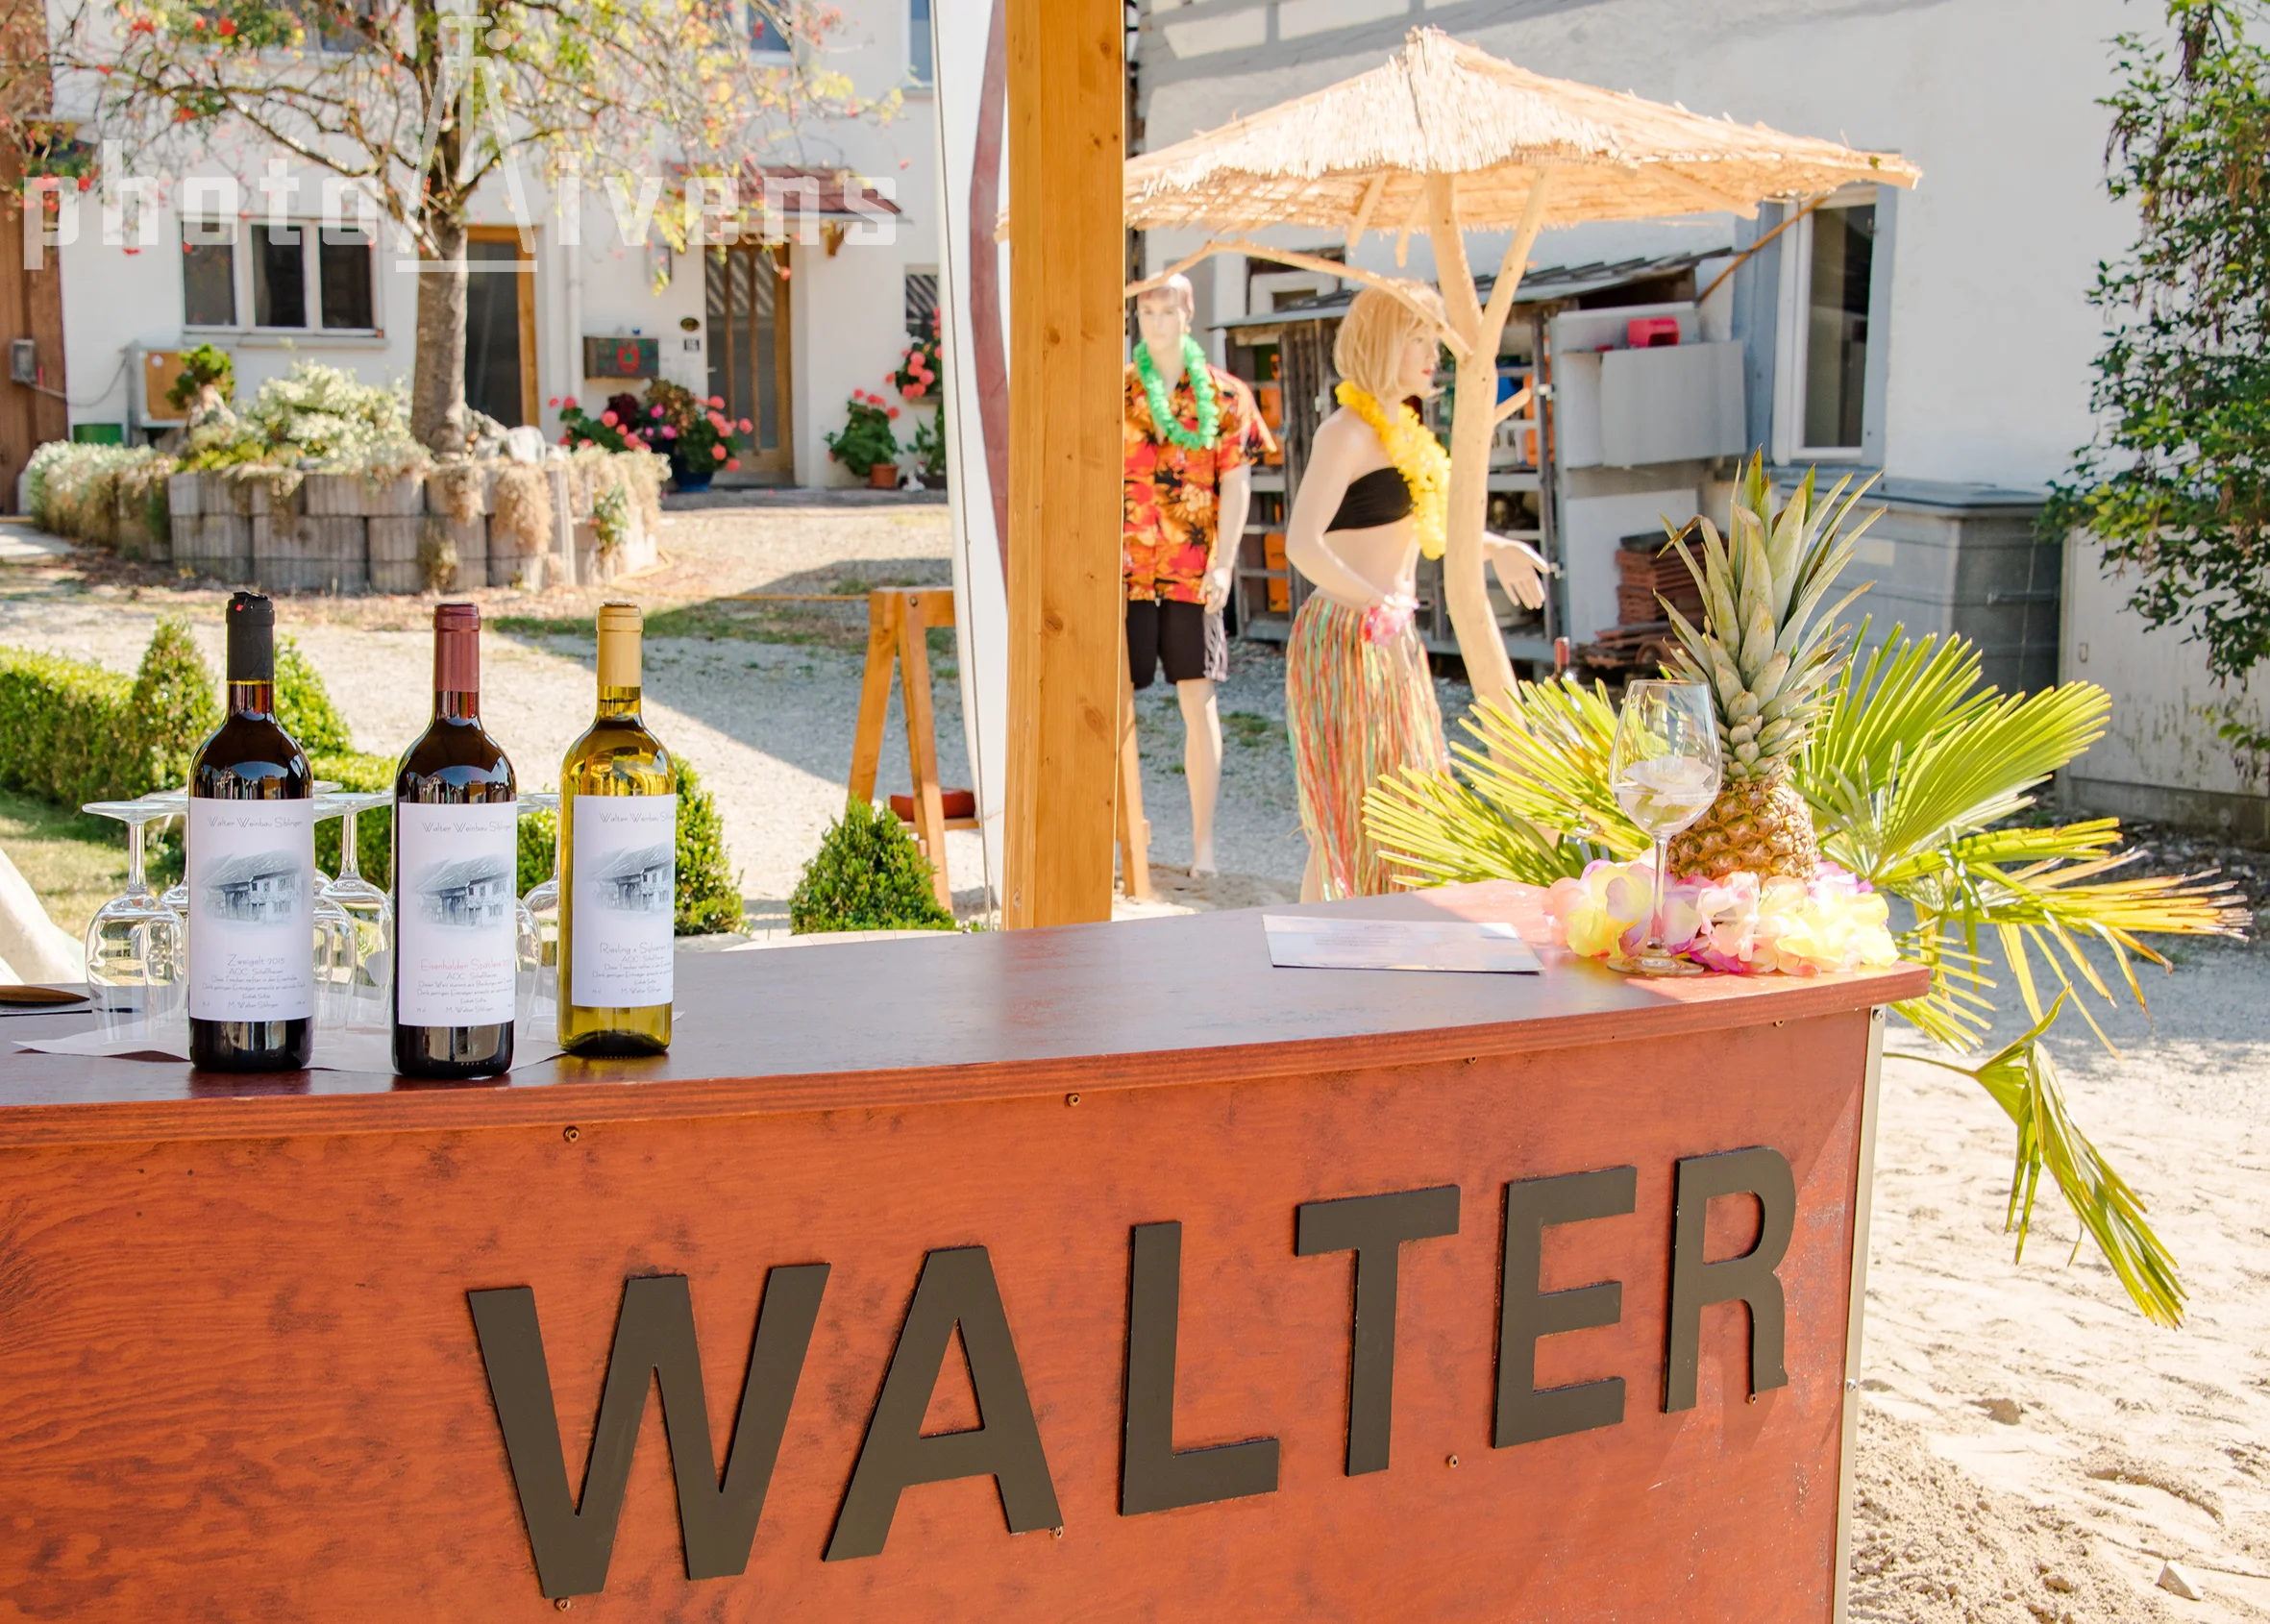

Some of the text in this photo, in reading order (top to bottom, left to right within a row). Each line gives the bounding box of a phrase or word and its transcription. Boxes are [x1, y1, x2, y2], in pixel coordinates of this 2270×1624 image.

[207, 816, 234, 827] Walter
[236, 816, 272, 828] Weinbau
[599, 812, 628, 824] Walter
[422, 822, 452, 833] Walter
[453, 822, 488, 833] Weinbau
[227, 953, 286, 968] Zweigelt 2015
[228, 968, 248, 976] AOC
[467, 1145, 1796, 1599] WALTER
